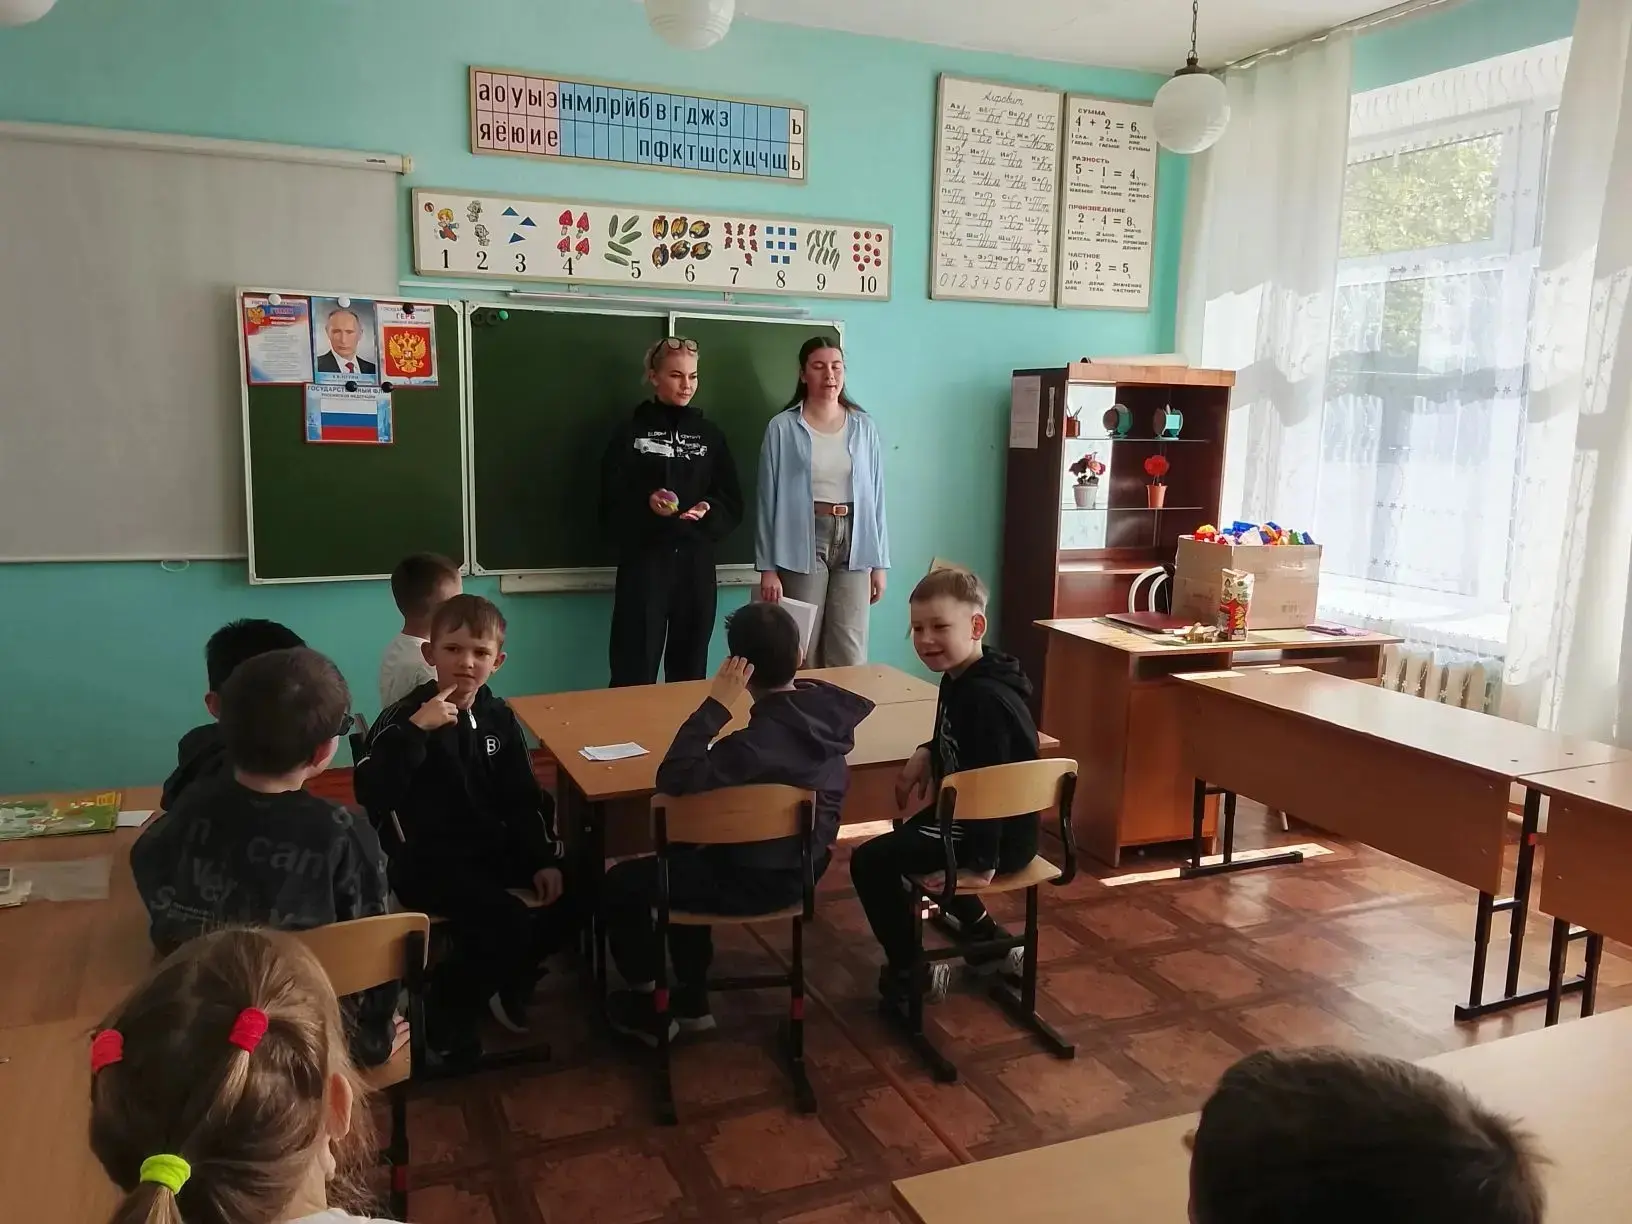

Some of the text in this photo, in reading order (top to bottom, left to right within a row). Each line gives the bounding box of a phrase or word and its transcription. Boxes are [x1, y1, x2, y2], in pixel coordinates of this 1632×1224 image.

[1078, 108, 1106, 116] СУММА
[1072, 155, 1110, 164] РАЗНОСТЬ
[1068, 204, 1126, 213] ПРОИЗВЕДЕНИЕ
[1069, 260, 1079, 271] 10
[441, 249, 877, 293] 1 2 3 4 5 6 7 8 9 10
[307, 385, 372, 394] ГОСУДАРСТНЫЙ
